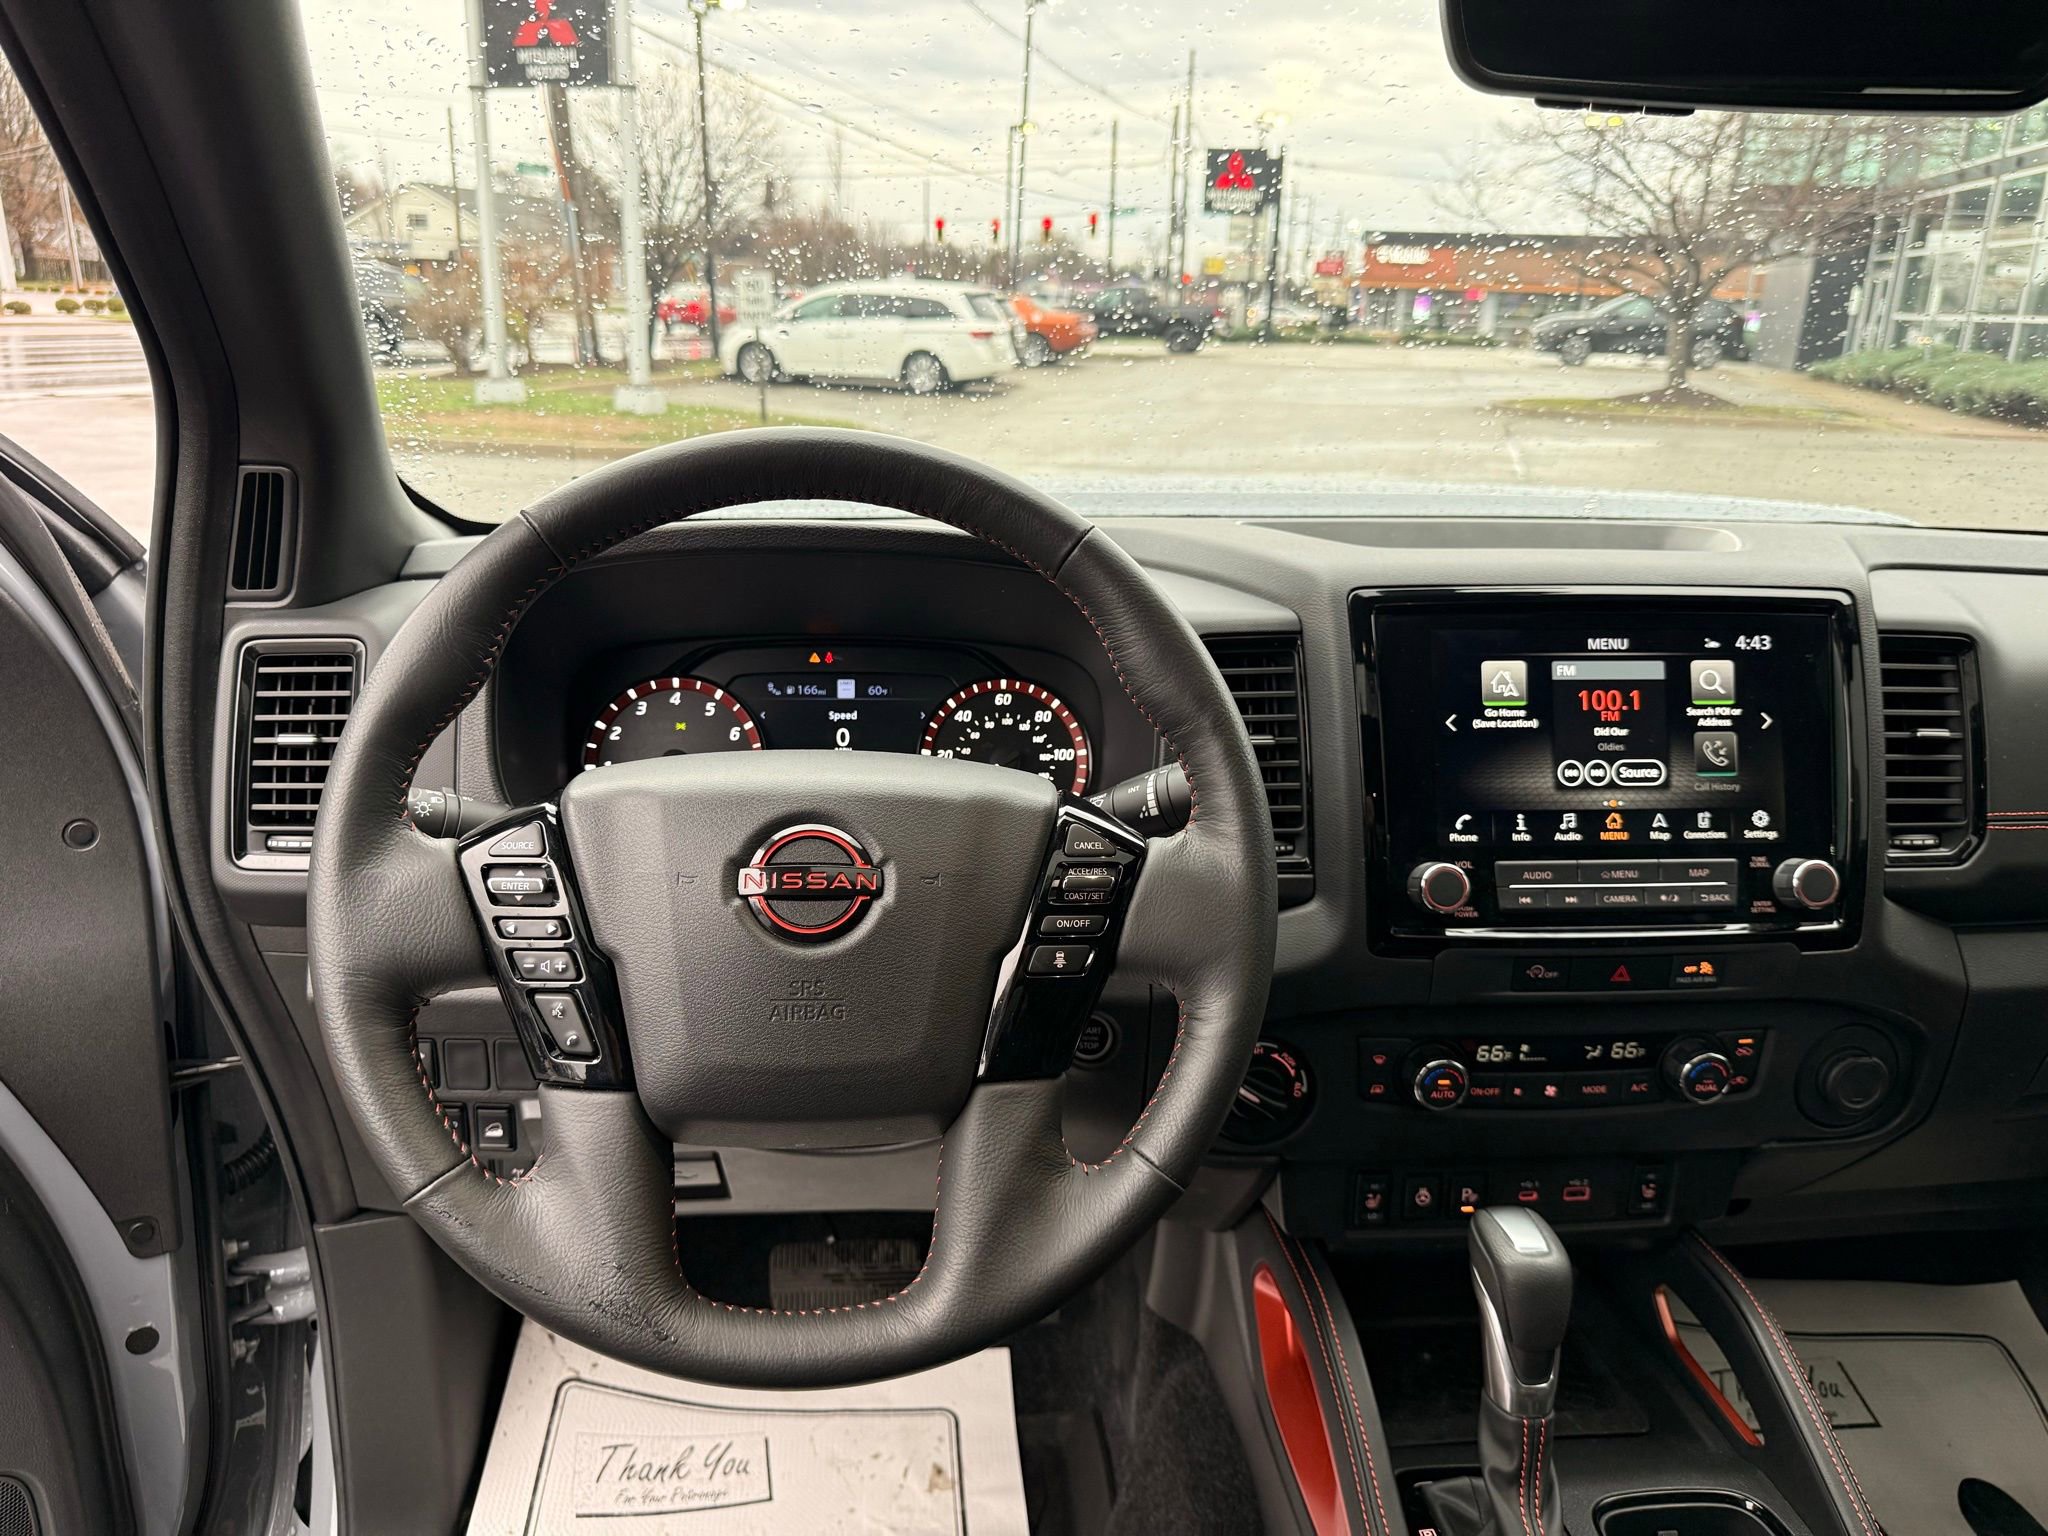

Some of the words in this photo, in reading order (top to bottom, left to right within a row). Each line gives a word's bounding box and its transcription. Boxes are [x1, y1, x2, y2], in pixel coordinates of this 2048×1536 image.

[1587, 638, 1630, 650] MENU
[1734, 635, 1772, 651] 4:43
[1556, 664, 1577, 676] FM
[669, 692, 681, 705] 4
[994, 693, 1012, 706] 60
[1578, 689, 1641, 711] 100.1
[635, 701, 648, 715] 3
[704, 702, 716, 716] 5
[1483, 708, 1498, 717] Go
[1498, 708, 1527, 717] Home
[1685, 707, 1714, 716] Search
[828, 710, 858, 722] Speed
[954, 710, 972, 722] 40
[1034, 711, 1052, 722] 80
[1600, 710, 1621, 721] FM
[1001, 717, 1013, 725] 100
[1472, 718, 1497, 729] (Save
[1497, 718, 1539, 729] Location)
[1697, 717, 1733, 727] Address
[609, 726, 622, 740] 2
[729, 727, 741, 741] 6
[835, 727, 850, 747] 0
[1593, 727, 1610, 737] Did
[1597, 742, 1625, 751] Oldies
[937, 749, 954, 759] 20
[1053, 749, 1075, 761] 100
[1619, 766, 1660, 778] Source
[1127, 785, 1140, 794] INT
[1694, 782, 1710, 791] Call
[1710, 783, 1741, 792] History
[1449, 832, 1479, 842] Phone
[1512, 832, 1532, 842] Info
[1554, 832, 1583, 841] Audio
[1600, 831, 1630, 841] MENU
[1650, 831, 1672, 842] Map
[1683, 830, 1728, 839] Connections
[1743, 829, 1779, 840] Settings
[501, 841, 534, 850] SOURCE
[1074, 841, 1104, 850] CANCEL
[1455, 861, 1474, 869] VOL
[1068, 867, 1108, 876] ACCEL/RES
[1522, 871, 1553, 880] AUDIO
[1611, 870, 1639, 879] MENU
[1689, 869, 1710, 877] MAP
[743, 871, 878, 890] NISSAN
[501, 882, 530, 891] ENTER
[1064, 892, 1105, 901] COAST/SET
[1603, 895, 1638, 903] CAMERA
[1708, 894, 1731, 902] BACK
[1454, 910, 1479, 918] POWER
[1056, 919, 1091, 928] ON/OFF
[789, 980, 826, 997] SRS
[769, 1004, 847, 1021] AIRBAG
[1582, 1085, 1607, 1094] MODE
[1631, 1083, 1648, 1092] A/C
[1695, 1083, 1718, 1092] DUAL
[1431, 1090, 1456, 1099] AUTO
[596, 1443, 695, 1484] Thank
[703, 1440, 751, 1480] You
